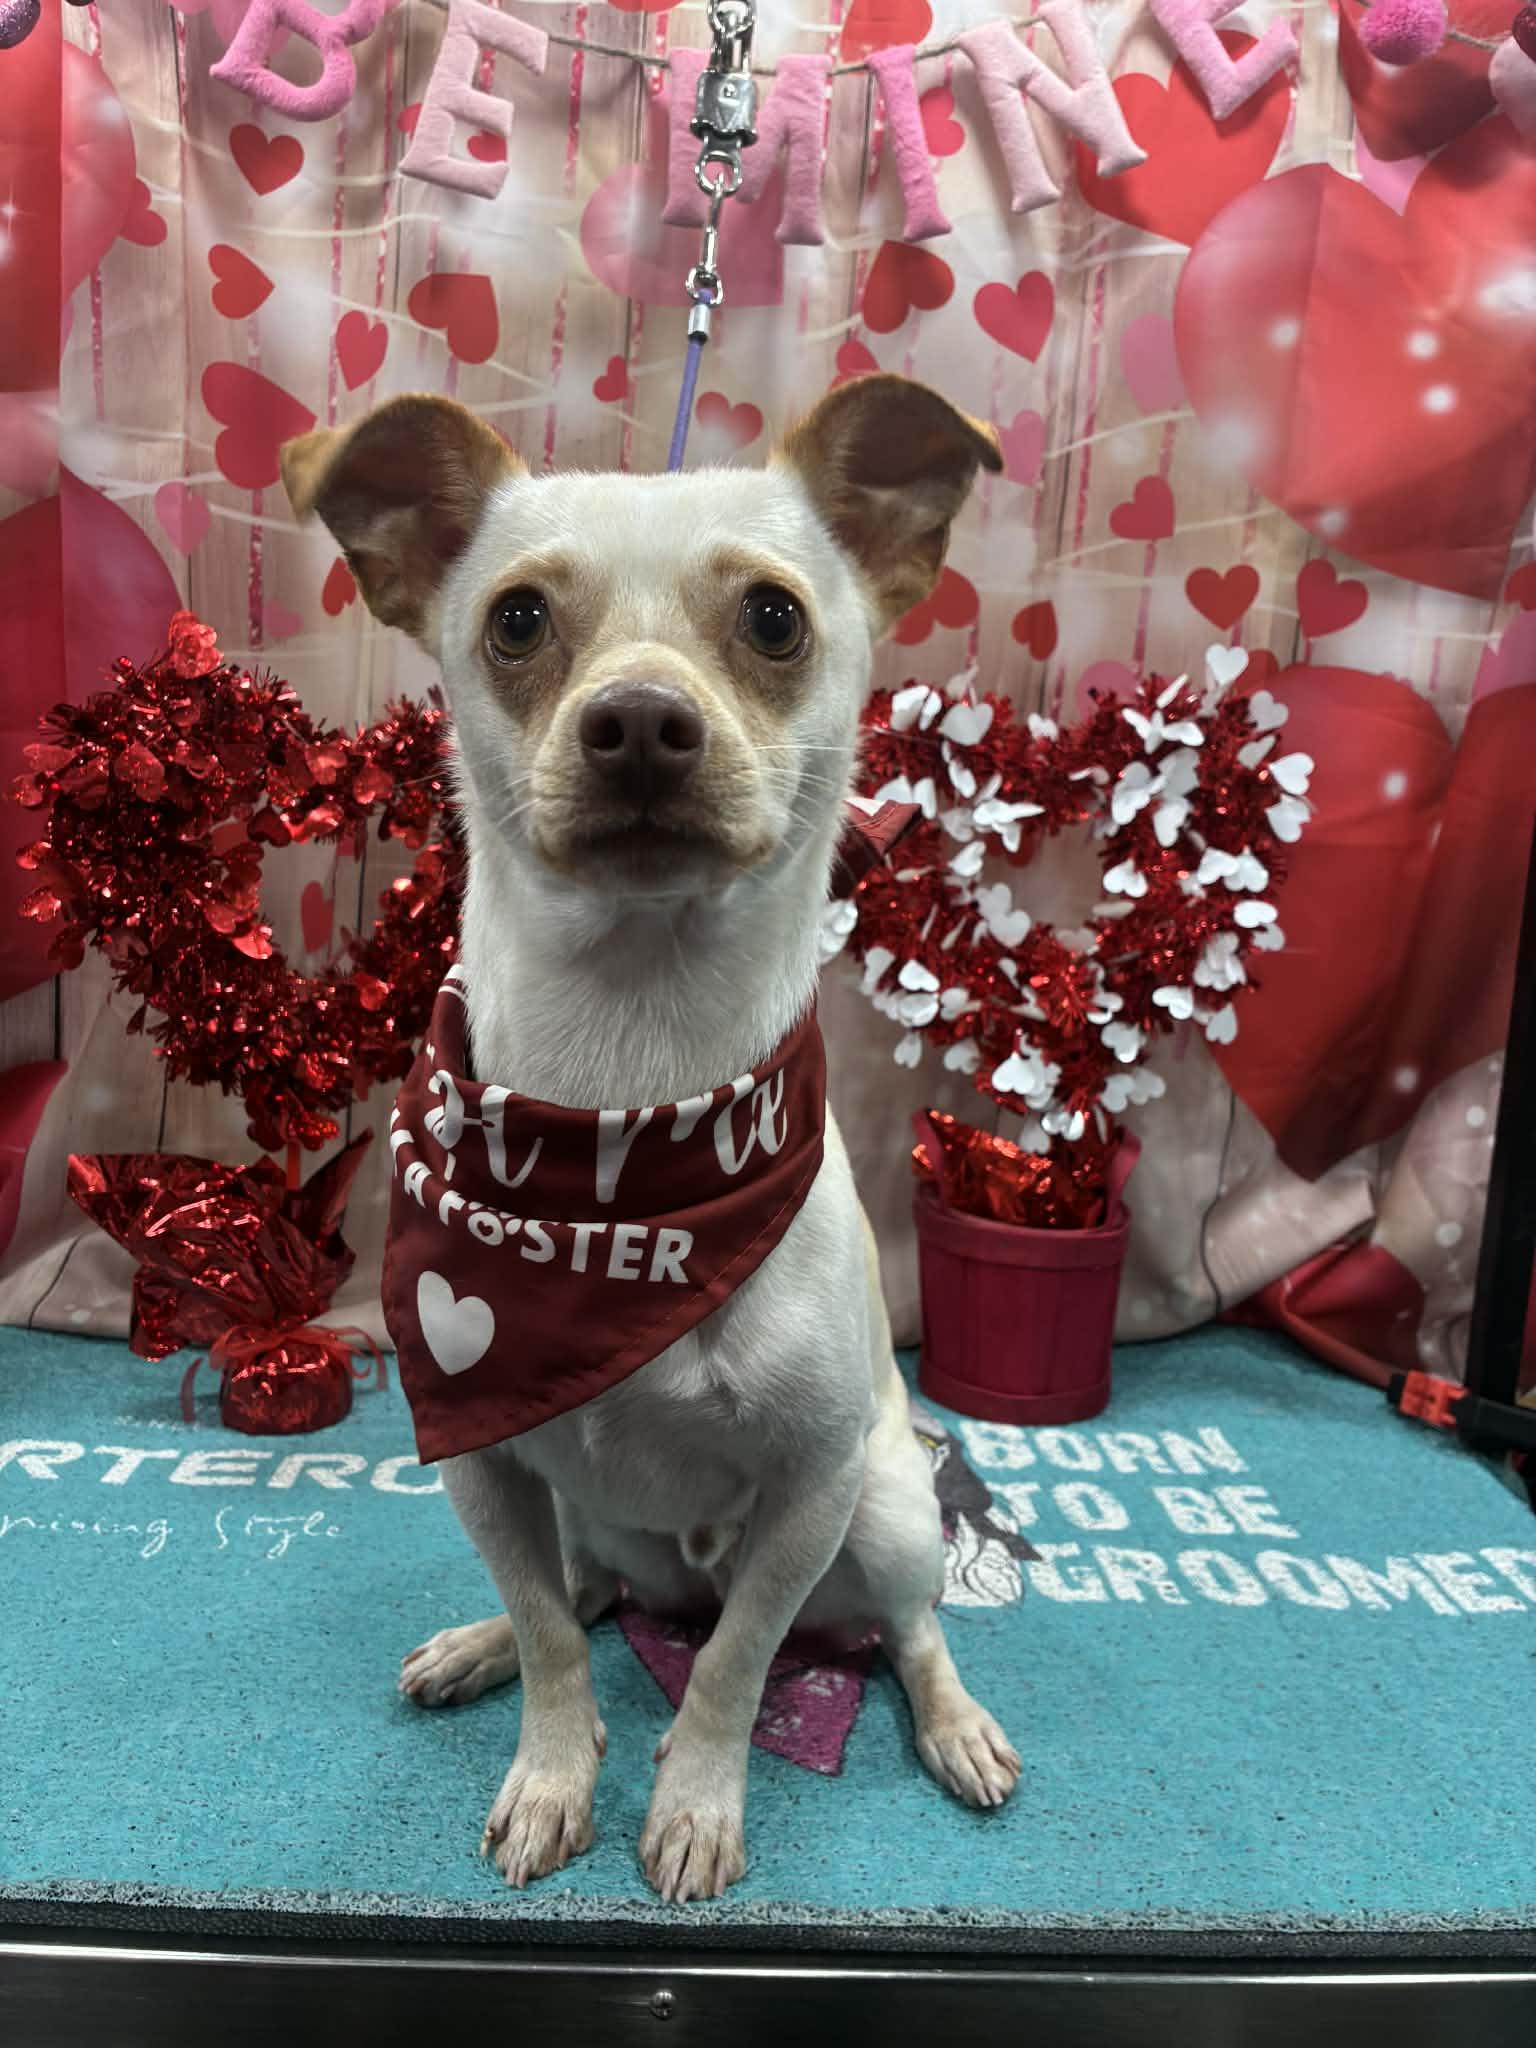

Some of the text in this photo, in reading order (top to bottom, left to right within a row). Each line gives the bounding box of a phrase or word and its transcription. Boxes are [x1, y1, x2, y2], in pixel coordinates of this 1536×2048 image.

[209, 0, 550, 200] BE
[958, 1420, 1251, 1475] BORN
[985, 1480, 1301, 1539] TO BE
